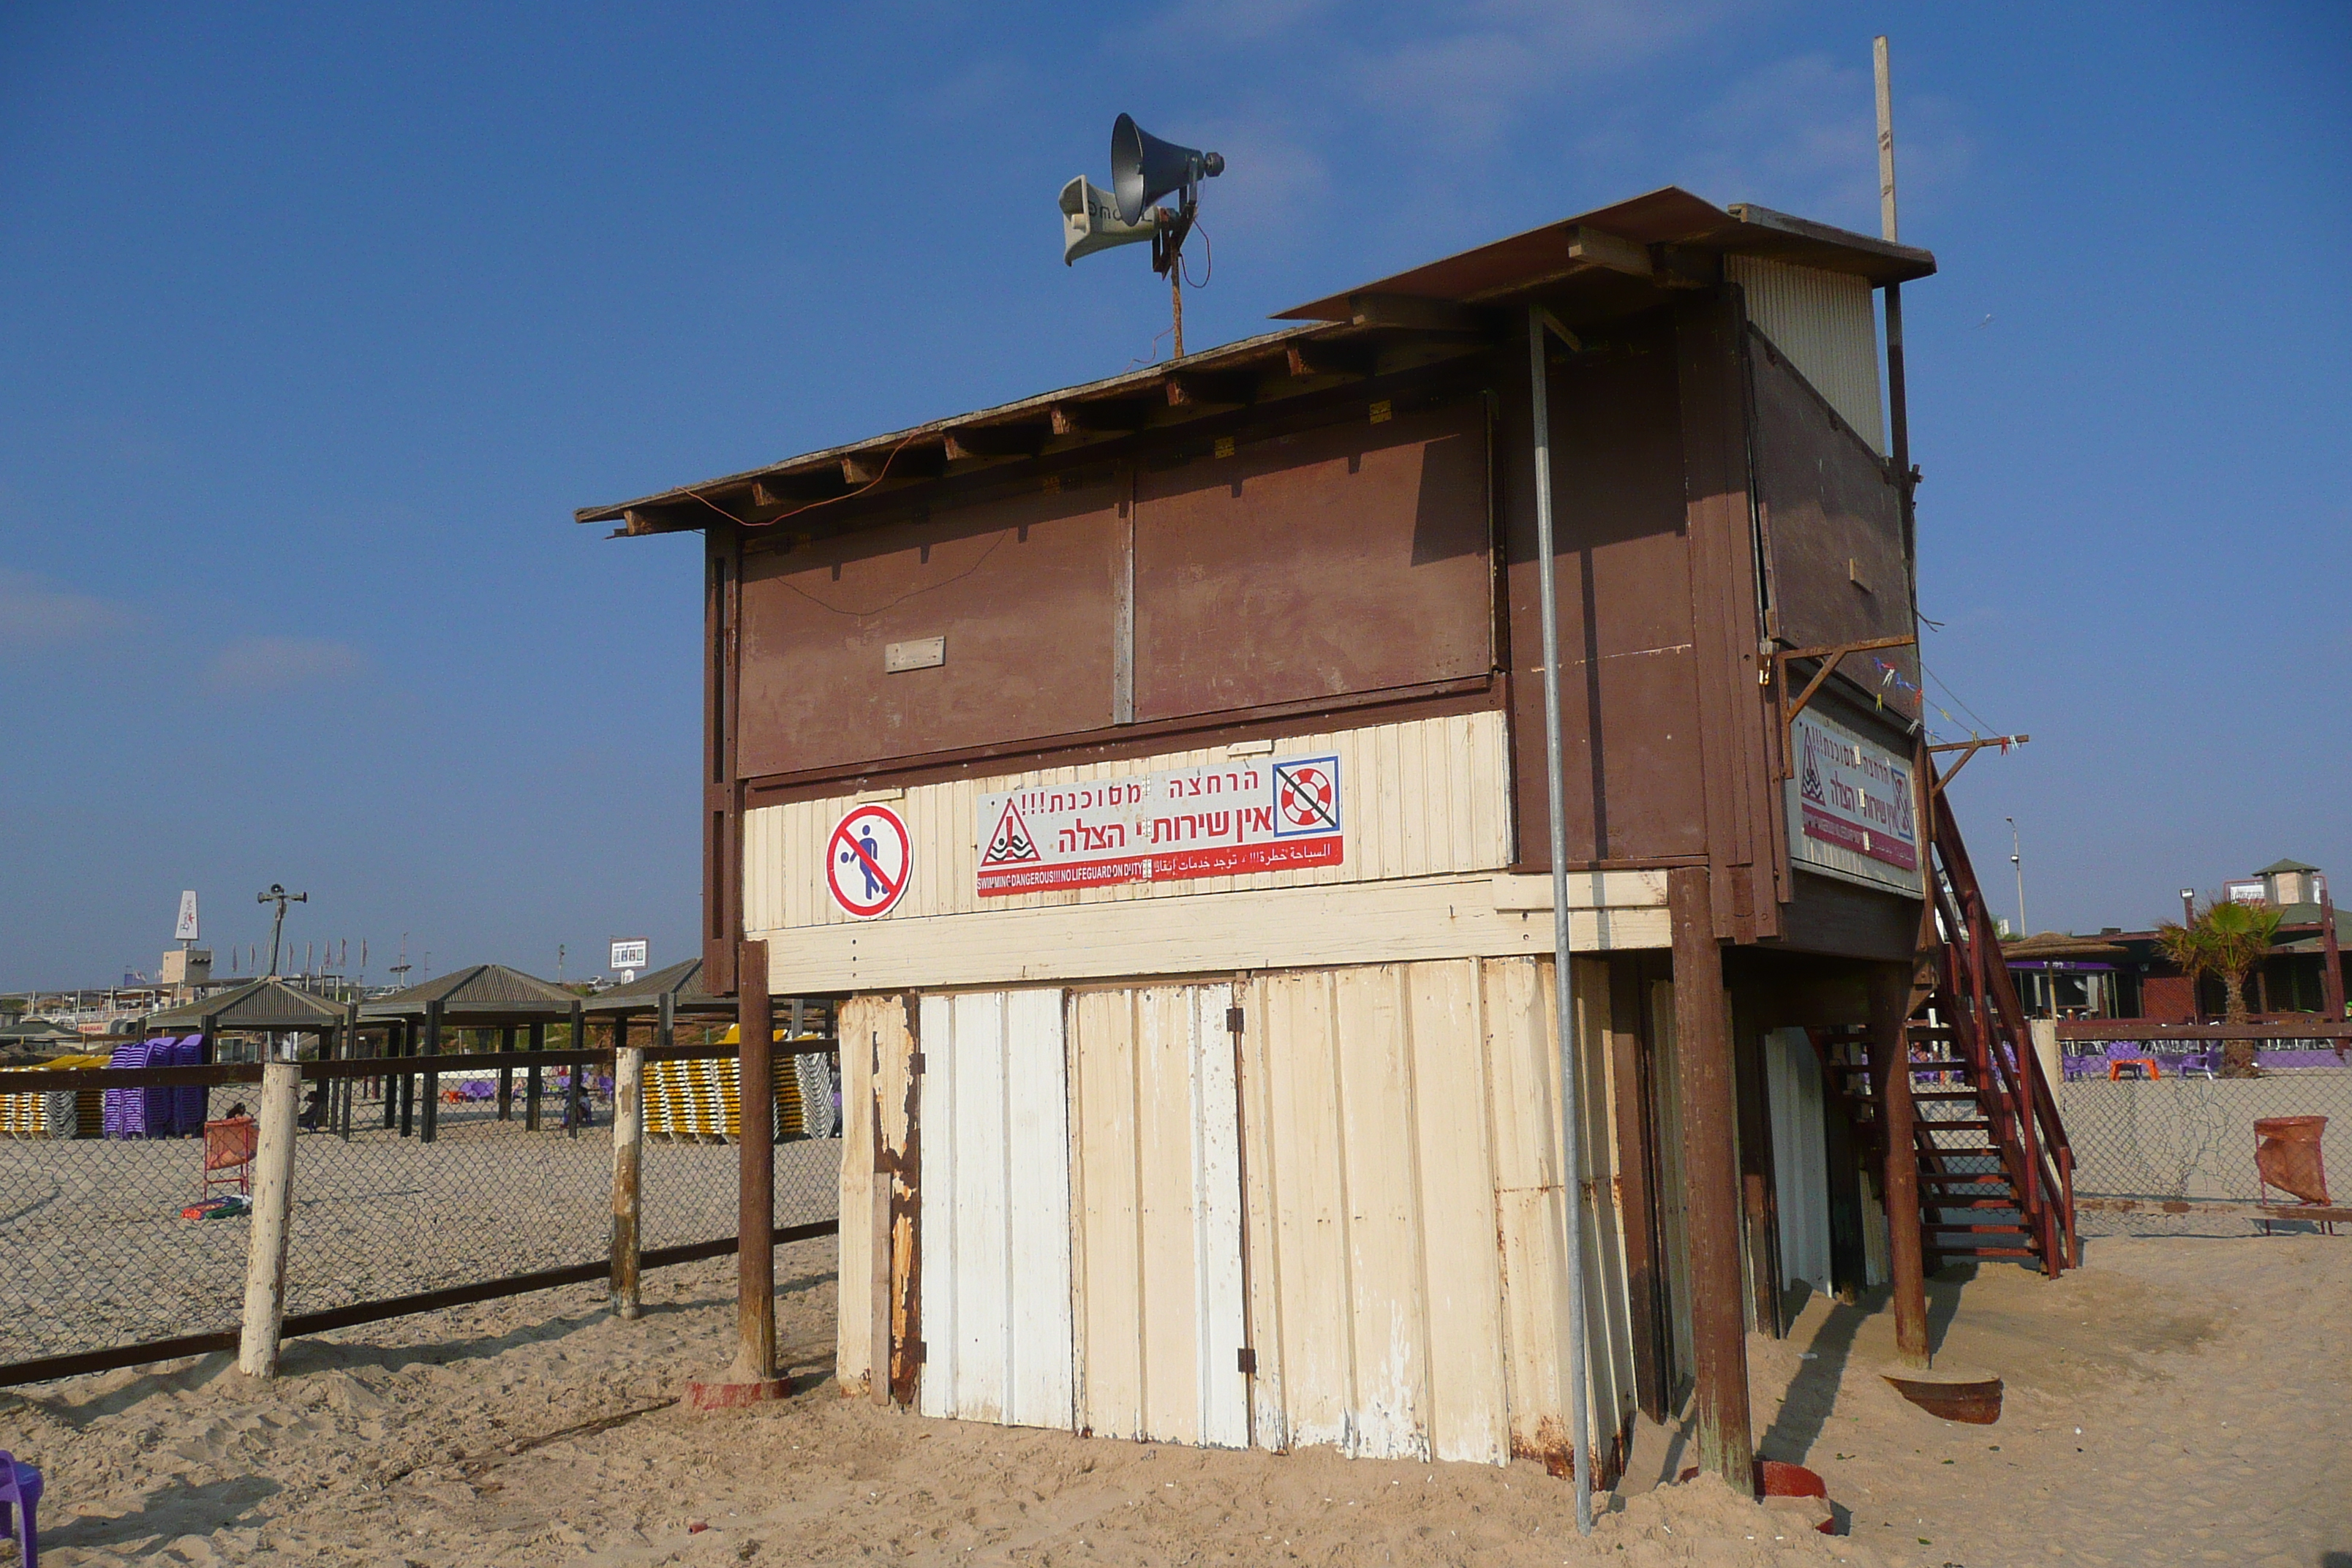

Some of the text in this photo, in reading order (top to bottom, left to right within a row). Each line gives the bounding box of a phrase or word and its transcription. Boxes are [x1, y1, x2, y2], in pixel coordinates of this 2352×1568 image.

[1812, 726, 1889, 785] הרחצה מסוכנת!!!
[1022, 770, 1259, 816] הרחצה מסוכנת!!!
[1830, 770, 1856, 813] הצלה
[1058, 805, 1273, 853] אין שירותי הצלה
[1886, 802, 1899, 835] אין
[1178, 856, 1210, 871] خدمات
[1213, 854, 1237, 871] توجد
[1290, 843, 1331, 860] السباحة
[977, 860, 1143, 890] SWIMMING DANGEROUS!!! NO LIFEGUARD ON DUTY
